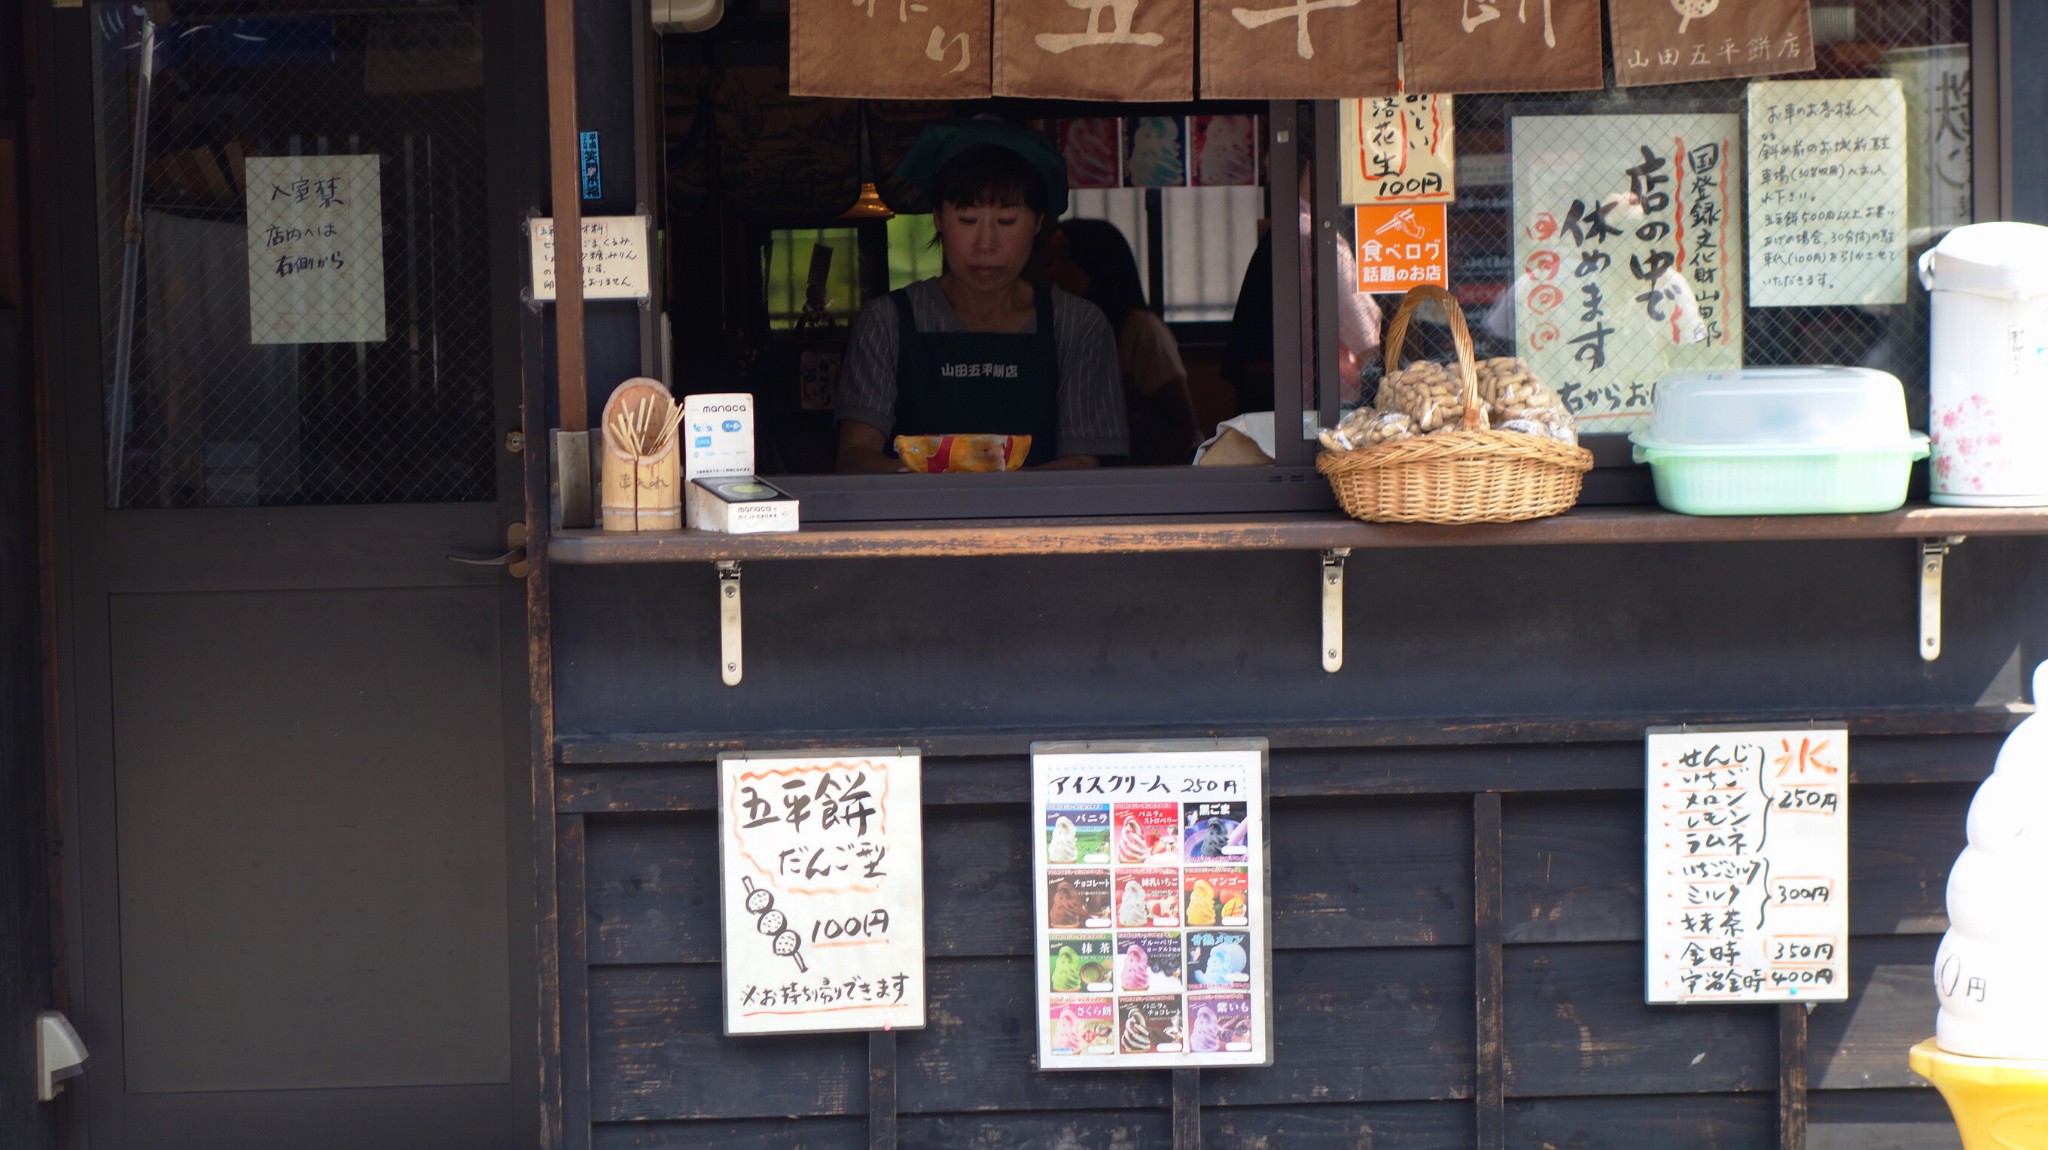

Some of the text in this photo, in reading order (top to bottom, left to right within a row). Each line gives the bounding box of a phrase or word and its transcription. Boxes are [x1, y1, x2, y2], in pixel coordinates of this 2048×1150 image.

[1627, 32, 1802, 70] 山田五平餅店
[1378, 172, 1443, 197] 100円
[1626, 145, 1684, 322] 店の中で
[1361, 238, 1442, 263] 食べログ
[1362, 264, 1442, 282] 話題のお店
[1559, 199, 1624, 374] 休めます
[941, 362, 1019, 378] 山田五平餅店
[702, 404, 747, 413] manaca
[1679, 744, 1753, 768] せんじ
[1774, 736, 1839, 778] 氷
[1050, 775, 1238, 796] アイスクリーム 250円
[1683, 768, 1750, 790] いちご
[740, 770, 877, 837] 五平餅
[1199, 803, 1231, 815] 黒ごま
[1686, 791, 1749, 809] メロン
[1777, 788, 1838, 813] 250円
[1075, 812, 1109, 824] バニラ
[1687, 809, 1751, 829] レモン
[1686, 827, 1747, 856] ラムネ
[778, 841, 888, 881] だんご型
[1073, 879, 1111, 889] チョコレート
[1208, 876, 1247, 886] マンゴー
[1688, 884, 1740, 906] ミルク
[1778, 885, 1830, 904] 300円
[811, 908, 890, 944] 100円
[1680, 908, 1744, 938] 抹茶
[1680, 940, 1741, 967] 金時
[1774, 942, 1834, 960] 350円
[1681, 969, 1767, 994] 宇治金時
[1771, 968, 1834, 986] 400円
[1077, 1005, 1112, 1017] さくら餅
[1216, 1001, 1250, 1013] 紫いも
